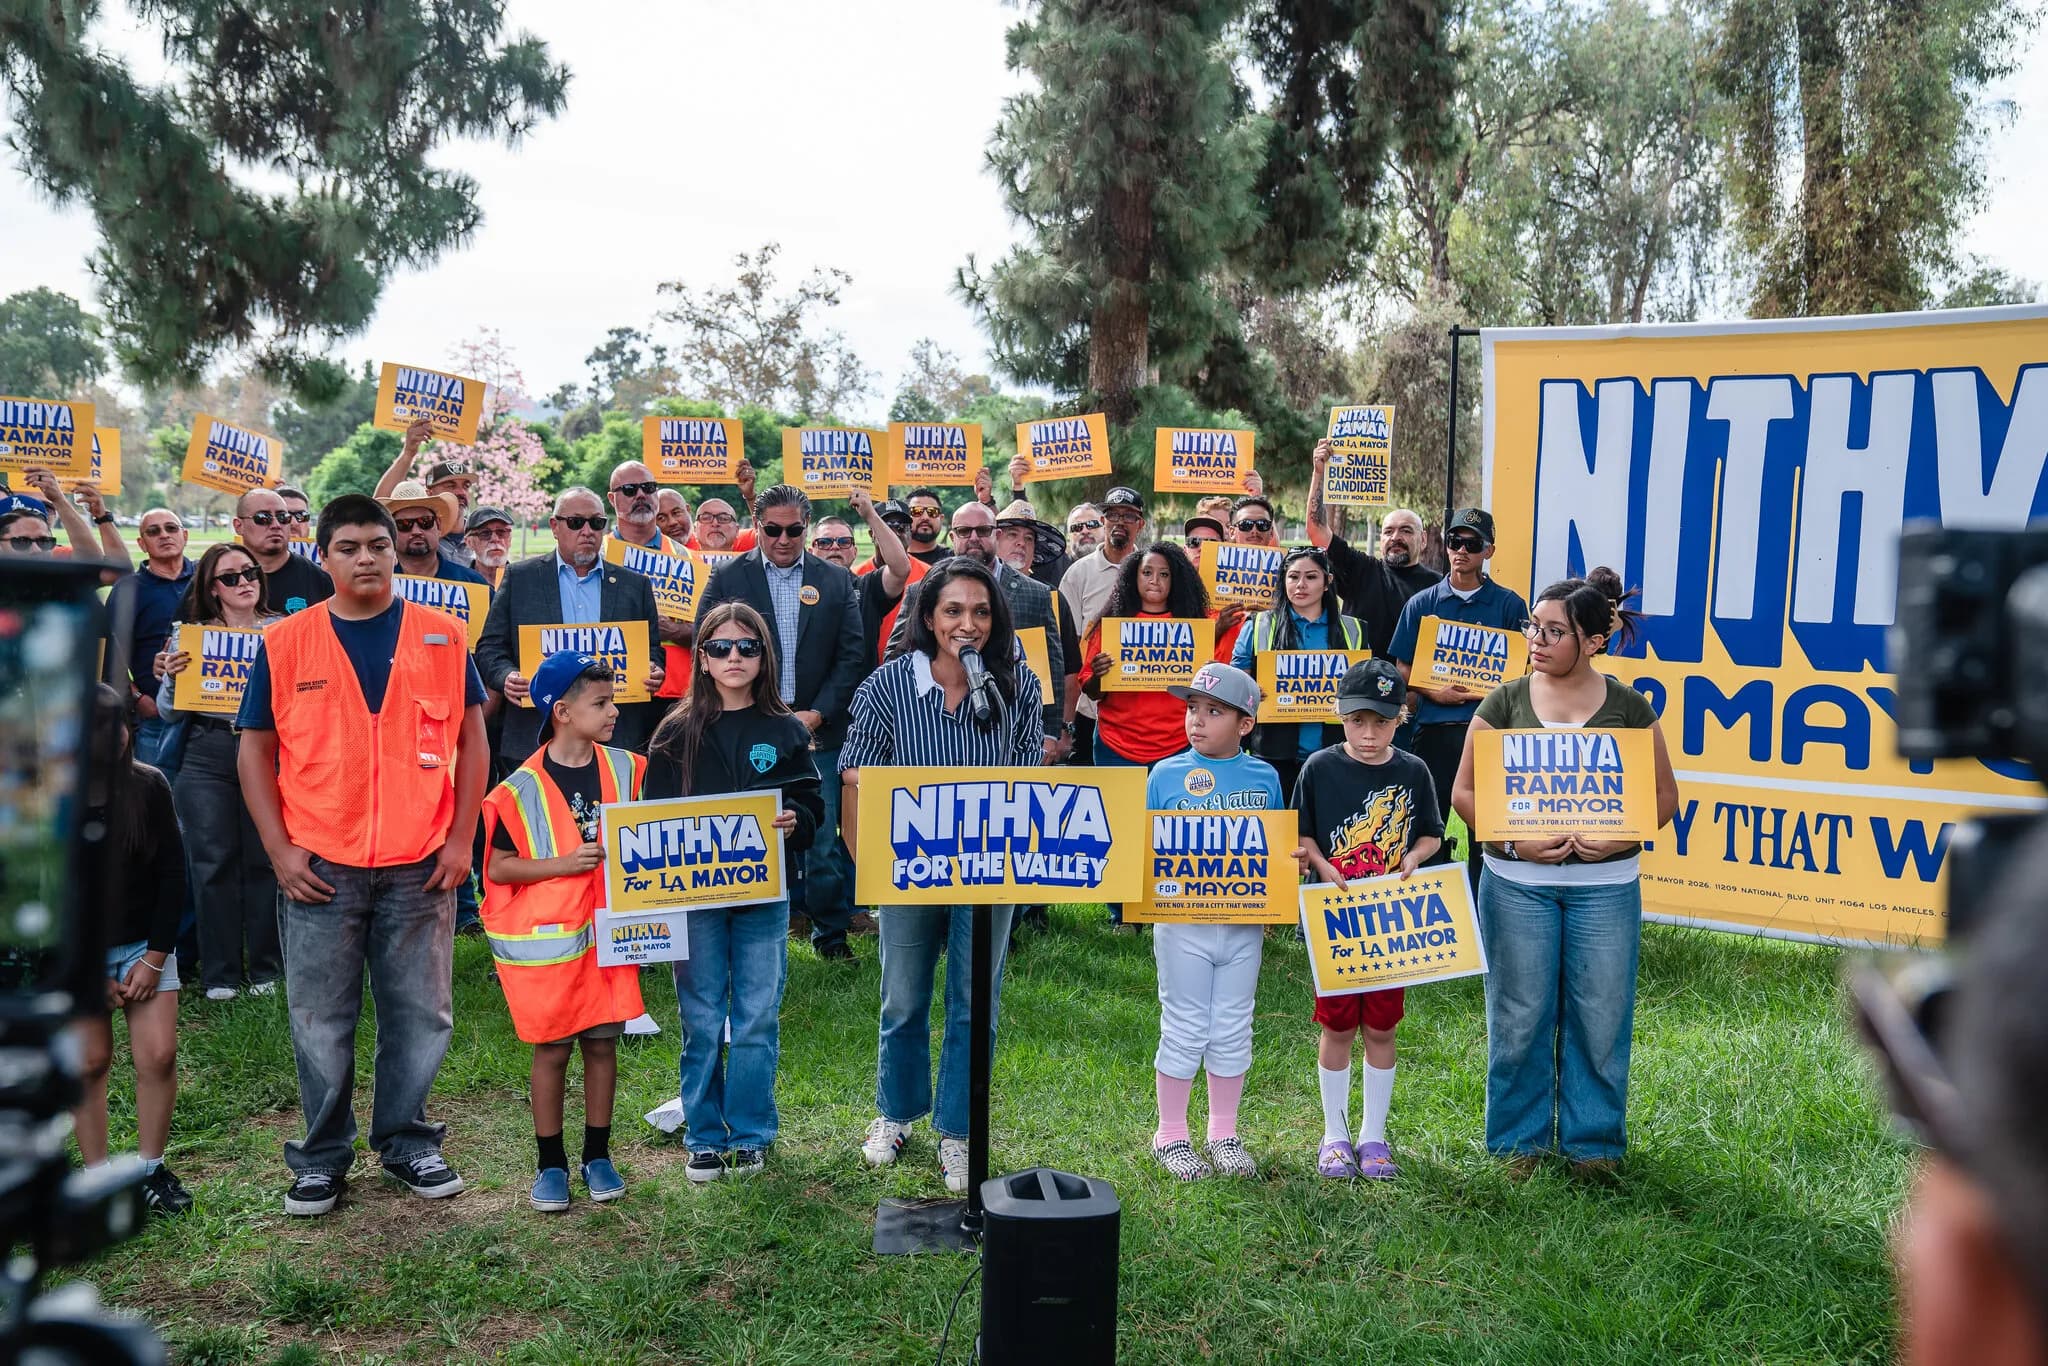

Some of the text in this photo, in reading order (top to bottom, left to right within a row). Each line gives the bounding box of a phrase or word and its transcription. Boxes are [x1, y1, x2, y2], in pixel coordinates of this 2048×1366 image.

[396, 368, 464, 404] NITHYA
[394, 392, 463, 416] RAMAN
[411, 409, 459, 426] MAYOR
[1338, 408, 1386, 424] NITHYA
[660, 420, 727, 445] NITHYA
[904, 426, 967, 449] NITHYA
[1030, 419, 1091, 446] NITHYA
[1332, 420, 1389, 440] RAMAN
[14, 445, 72, 458] MAYOR
[209, 421, 268, 464] NITHYA
[661, 445, 727, 457] RAMAN
[800, 430, 873, 458] NITHYA
[1032, 441, 1091, 458] RAMAN
[1172, 431, 1237, 456] NITHYA
[1347, 440, 1357, 448] LA
[205, 446, 267, 476] RAMAN
[680, 459, 727, 468] MAYOR
[802, 457, 873, 471] RAMAN
[905, 449, 966, 461] RAMAN
[1050, 454, 1092, 465] MAYOR
[1172, 455, 1236, 468] RAMAN
[1347, 454, 1387, 467] SMALL
[220, 465, 264, 486] MAYOR
[823, 472, 872, 483] MAYOR
[921, 463, 966, 471] MAYOR
[1189, 469, 1235, 478] MAYOR
[1329, 467, 1386, 480] BUSINESS
[1328, 480, 1385, 493] CANDIDATE
[11, 497, 25, 510] LA
[623, 545, 694, 584] NITHYA
[1217, 546, 1284, 574] NITHYA
[394, 577, 470, 610] NITHYA
[1233, 587, 1274, 598] MAYO
[541, 627, 627, 657] NITHYA
[1120, 622, 1194, 648] NITHYA
[1436, 623, 1508, 659] NITHYA
[202, 631, 264, 663] NITH
[1121, 649, 1193, 662] RAMAN
[1141, 665, 1192, 674] MAYOR
[1276, 654, 1349, 679] NITHYA
[1434, 649, 1506, 672] RAMAN
[1450, 667, 1502, 683] MAYOR
[1503, 733, 1624, 773] NITHYA
[1506, 775, 1623, 795] RAMAN
[1214, 789, 1267, 810] Valley
[1512, 798, 1624, 813] FOR MAYOR
[890, 781, 1113, 858] NITHYA
[618, 814, 767, 874] NITHYA
[1153, 815, 1269, 856] NITHYA
[1714, 801, 1852, 875] THAT
[623, 864, 768, 893] For LA MAYOR
[892, 851, 1109, 890] FOR THE VALLEY
[1154, 858, 1267, 878] RAMAN
[1159, 882, 1266, 896] FOR MAYOR
[1658, 876, 1684, 885] MAYOR
[1715, 884, 1737, 892] 11209
[1741, 887, 1783, 898] NATIONAL
[1815, 897, 1835, 905] UNIT
[1324, 893, 1453, 940] NITHYA
[612, 922, 672, 944] NITHYA
[1330, 927, 1457, 959] For LA MAYOR
[643, 942, 671, 951] MAYOR
